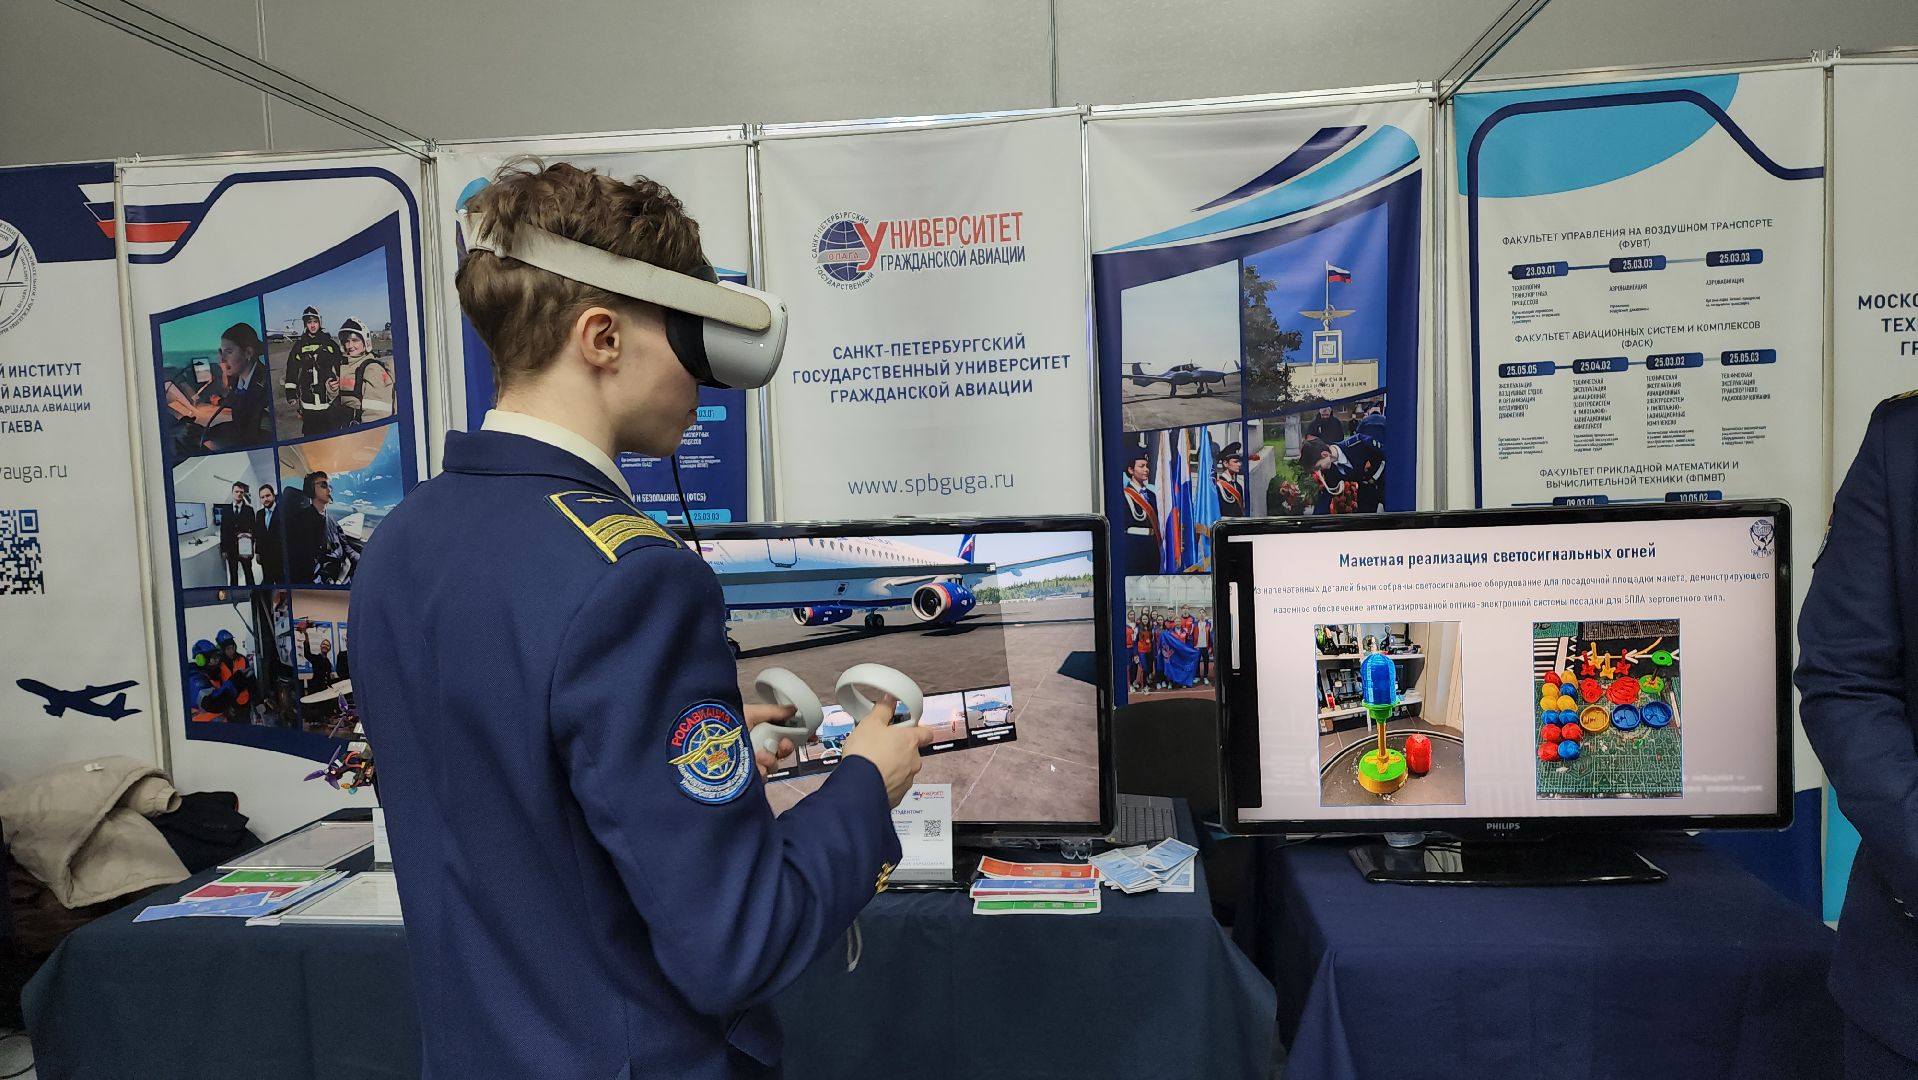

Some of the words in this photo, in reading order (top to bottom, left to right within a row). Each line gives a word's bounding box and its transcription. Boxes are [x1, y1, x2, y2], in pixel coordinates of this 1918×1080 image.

[1502, 233, 1559, 246] ФАКУЛЬТЕТ
[1562, 229, 1626, 242] УПРАВЛЕНИЯ
[1629, 227, 1642, 237] НА
[1645, 222, 1708, 236] ВОЗДУШНОМ
[1710, 218, 1773, 231] ТРАНСПОРТЕ
[854, 212, 1023, 271] УНИВЕРСИТЕТ
[1618, 238, 1651, 250] (ФУВТ)
[880, 246, 967, 272] ГРАЖДАНСКОЙ
[969, 245, 1026, 267] АВИАЦИИ
[1622, 258, 1653, 270] 25.03.03
[1719, 252, 1751, 264] 25.03.03
[1525, 265, 1556, 277] 23.03.01
[1514, 331, 1570, 344] ФАКУЛЬТЕТ
[1572, 326, 1645, 341] АВИАЦИОННЫХ
[1647, 324, 1685, 336] СИСТЕМ
[1688, 324, 1694, 333] И
[1696, 320, 1761, 333] КОМПЛЕКСОВ
[832, 332, 1026, 360] САНКТ-ПЕТЕРБУРГСКИЙ
[1621, 338, 1653, 350] (ФАСК)
[1654, 356, 1686, 368] 25.03.02
[1729, 351, 1760, 363] 25.05.03
[9, 362, 82, 379] ИНСТИТУТ
[793, 358, 950, 384] ГОСУДАРСТВЕННЫЙ
[955, 354, 1071, 375] УНИВЕРСИТЕТ
[1506, 363, 1538, 376] 25.05.05
[1580, 360, 1612, 372] 25.04.02
[13, 383, 83, 400] АВИАЦИИ
[830, 381, 950, 404] ГРАЖДАНСКОЙ
[955, 379, 1034, 398] АВИАЦИИ
[42, 401, 91, 414] АВИАЦИИ
[1, 420, 43, 434] ГАЕВА
[1539, 465, 1594, 478] ФАКУЛЬТЕТ
[1596, 462, 1662, 477] ПРИКЛАДНОЙ
[1665, 461, 1730, 473] МАТЕМАТИКИ
[1732, 461, 1739, 470] И
[847, 473, 1014, 497] www.spbguga.ru
[1546, 474, 1637, 489] ВЫЧИСЛИТЕЛЬНОЙ
[1639, 474, 1683, 485] ТЕХНИКИ
[1685, 472, 1726, 484] (ФПМВТ)
[1339, 552, 1404, 568] Макетная
[1408, 551, 1488, 569] реализация
[1493, 546, 1612, 563] светосигнальных
[1616, 542, 1656, 559] огней
[1415, 580, 1483, 590] светосигнальное
[1484, 578, 1542, 590] оборудование
[1562, 574, 1610, 586] посадочной
[1690, 572, 1770, 583] демонстрирующего
[1533, 598, 1567, 607] системы
[1486, 822, 1521, 830] PHILIPS
